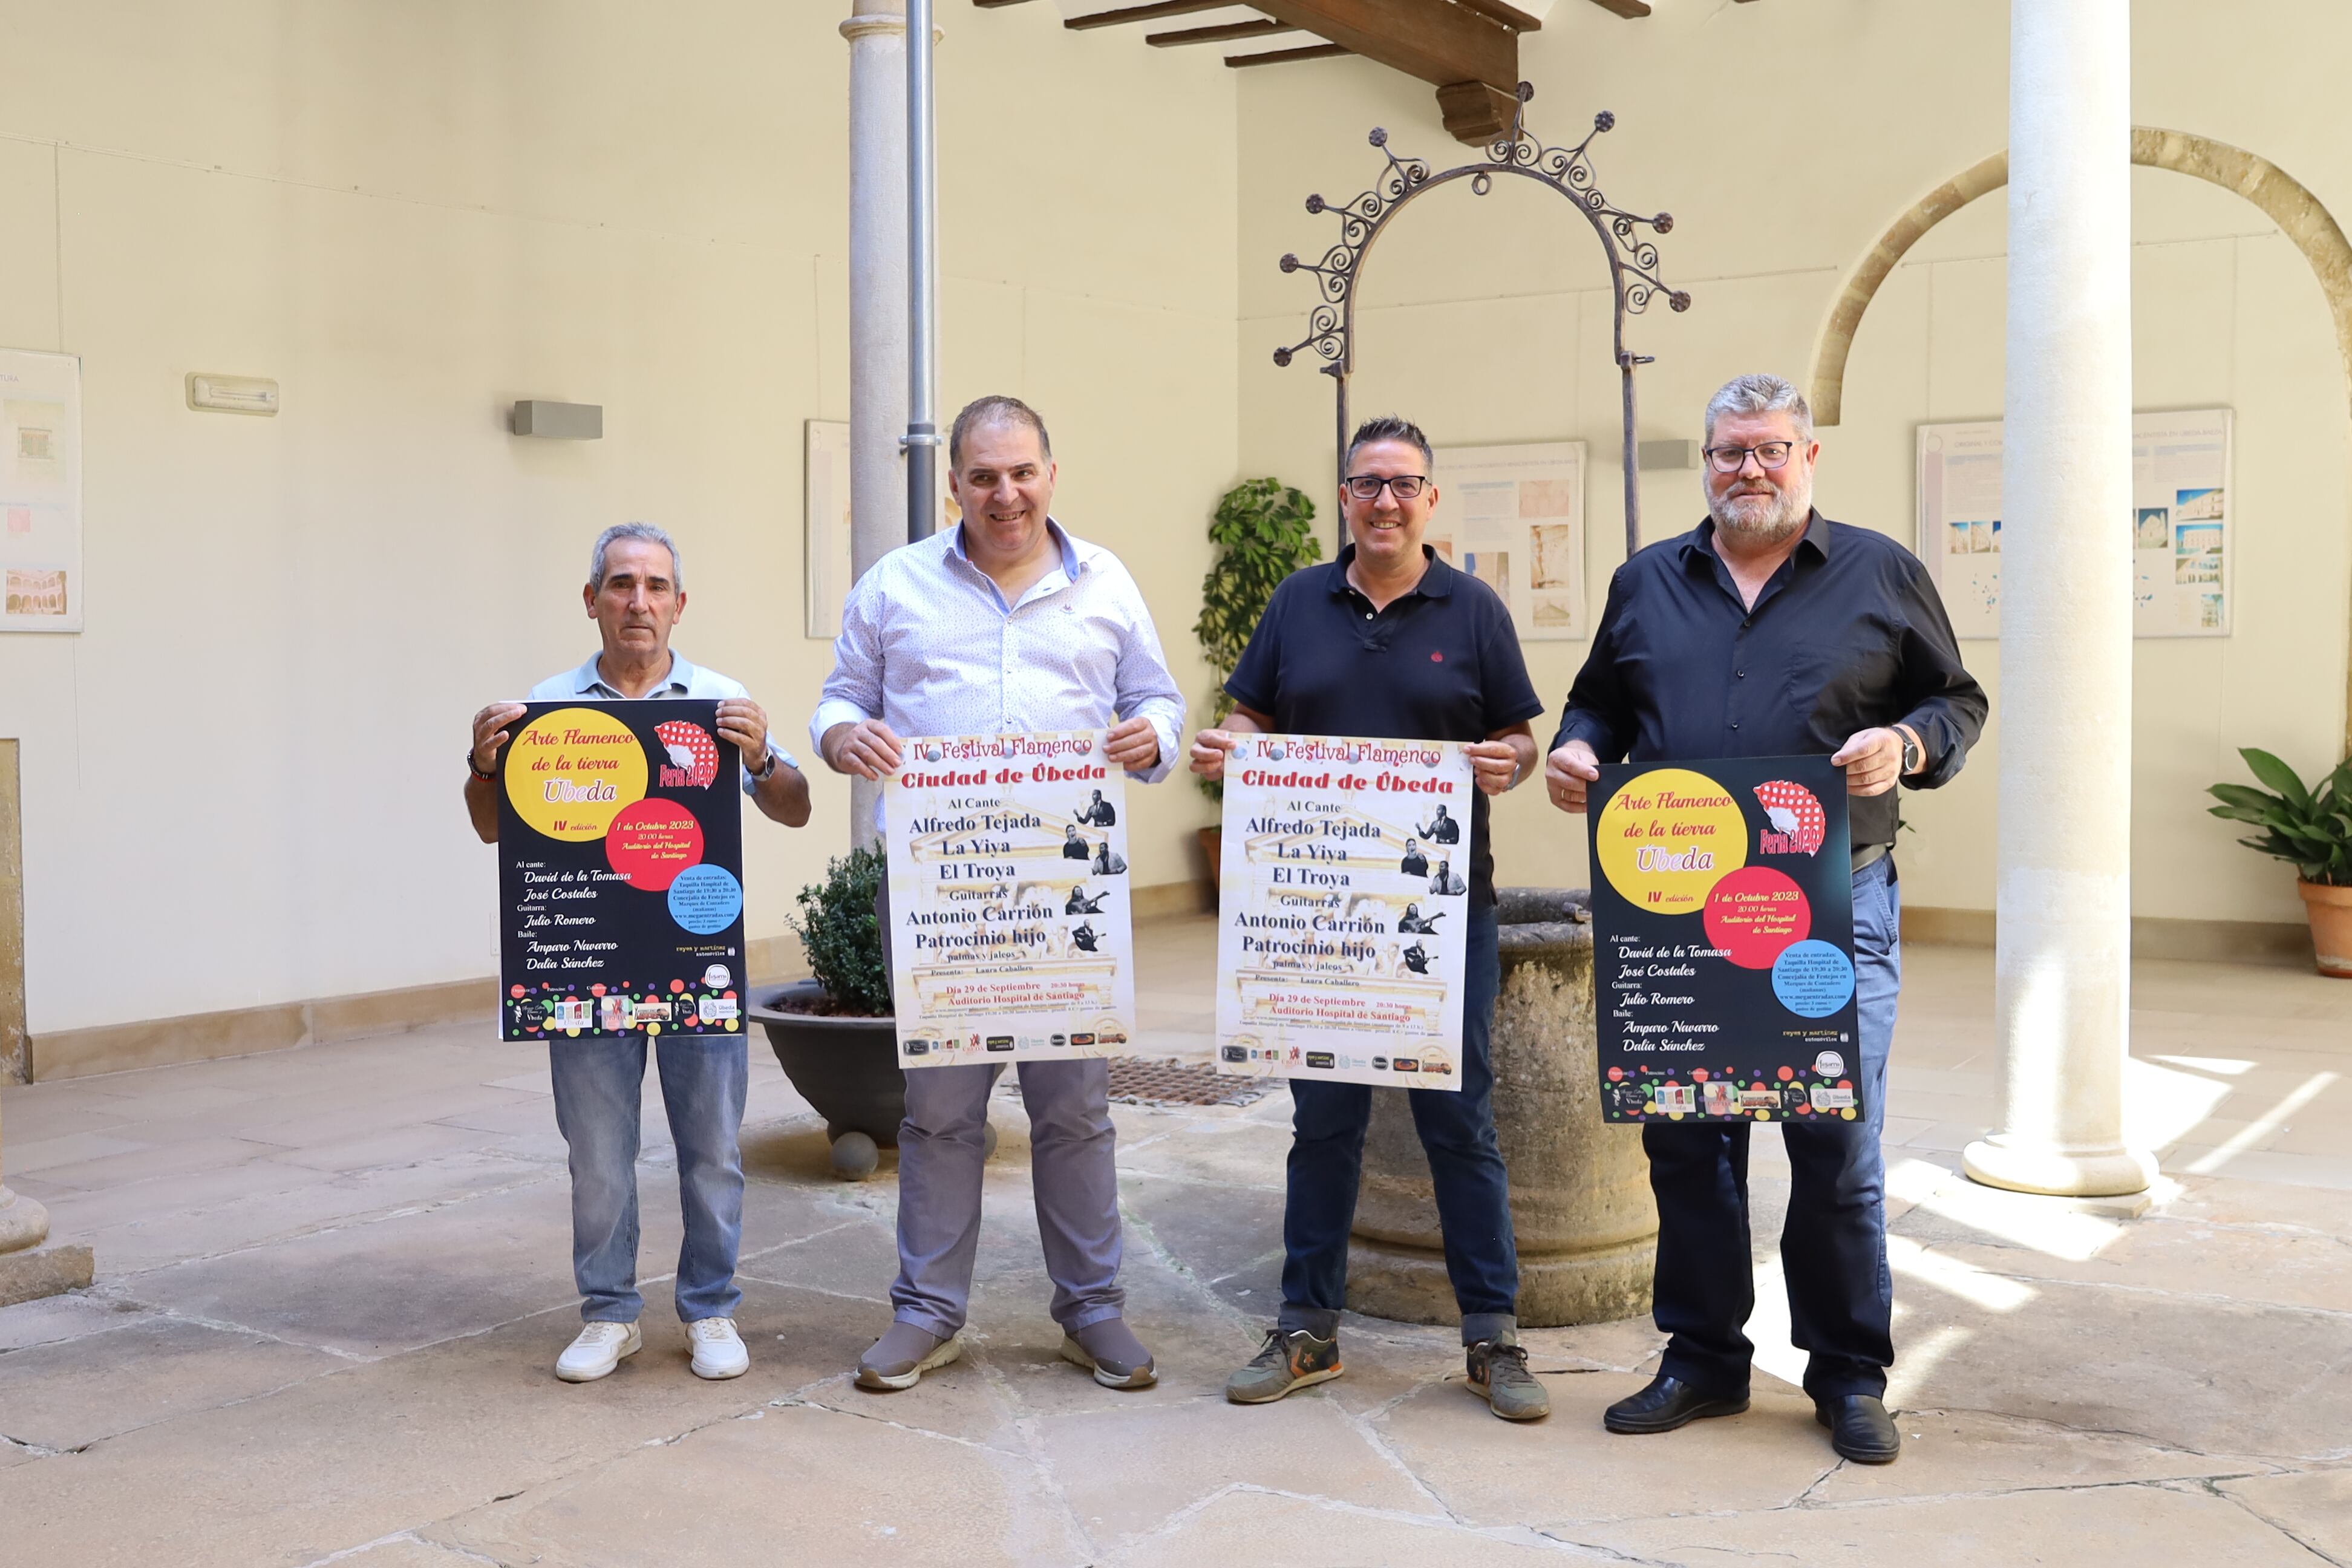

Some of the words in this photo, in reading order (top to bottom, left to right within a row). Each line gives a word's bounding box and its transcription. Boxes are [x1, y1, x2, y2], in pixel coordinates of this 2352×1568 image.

[522, 730, 559, 745] Arte
[563, 729, 636, 745] Flamenco
[913, 743, 930, 760] IV
[941, 738, 1005, 759] Festival
[1011, 737, 1093, 758] Flamenco
[1257, 740, 1274, 757] IV
[1284, 741, 1351, 760] Festival
[1357, 743, 1442, 766] Flamenco
[532, 757, 550, 771] de
[555, 755, 572, 770] la
[578, 757, 619, 770] tierra
[659, 763, 685, 787] Feria
[901, 769, 987, 788] Ciudad
[995, 768, 1023, 783] de
[1031, 762, 1106, 782] Úbeda
[1242, 769, 1330, 788] Ciudad
[1338, 774, 1367, 790] de
[1376, 771, 1452, 794] Úbeda
[544, 777, 617, 803] Úbeda
[948, 799, 961, 809] Al
[965, 798, 1001, 808] Cante
[1287, 800, 1301, 811] Al
[1305, 801, 1341, 813] Cante
[1614, 794, 1651, 811] Arte
[1656, 791, 1733, 809] Flamenco
[554, 820, 567, 831] IV
[570, 823, 598, 831] edición
[616, 822, 621, 831] 1
[635, 822, 667, 831] Octubre
[668, 820, 694, 830] 2023
[909, 817, 976, 834] Alfredo
[981, 814, 1041, 833] Tejada
[1246, 817, 1314, 834] Alfredo
[1320, 820, 1381, 840] Tejada
[1624, 822, 1644, 837] de
[1649, 820, 1666, 837] la
[1671, 822, 1716, 836] tierra
[665, 841, 691, 850] Hospital
[942, 841, 965, 855] La
[971, 839, 1010, 857] Yiya
[1760, 829, 1788, 854] Feria
[661, 852, 687, 860] Santiago
[1278, 843, 1301, 859] La
[1307, 844, 1347, 864] Yiya
[1636, 844, 1714, 872] Úbeda
[524, 872, 558, 883] David
[561, 872, 574, 881] de
[577, 870, 588, 881] la
[590, 870, 632, 881] Tomasa
[939, 864, 959, 880] El
[964, 863, 1016, 881] Troya
[1273, 867, 1292, 883] El
[1298, 868, 1350, 889] Troya
[524, 888, 549, 902] José
[552, 887, 598, 900] Costales
[950, 890, 1007, 901] Guitarras
[1281, 895, 1340, 908] Guitarras
[1648, 892, 1662, 903] IV
[1665, 894, 1694, 903] edición
[1714, 893, 1719, 903] 1
[1722, 893, 1733, 903] de
[1735, 892, 1769, 902] Octubre
[1772, 891, 1798, 901] 2023
[524, 914, 552, 928] Julio
[554, 914, 596, 926] Romero
[906, 909, 976, 926] Antonio
[982, 904, 1053, 922] Carrión
[1767, 914, 1796, 923] Hospital
[1235, 912, 1306, 929] Antonio
[1313, 915, 1385, 934] Carrión
[1763, 926, 1792, 934] Santiago
[915, 930, 1006, 949] Patrocinio
[1013, 929, 1046, 947] hijo
[527, 941, 571, 955] Amparo
[573, 939, 618, 951] Navarro
[1243, 936, 1334, 956] Patrocinio
[1341, 941, 1376, 961] hijo
[1618, 946, 1654, 958] David
[1656, 946, 1670, 958] de
[1673, 945, 1685, 958] la
[1688, 945, 1732, 958] Tomasa
[526, 958, 558, 970] Dalia
[561, 956, 605, 969] Sánchez
[947, 954, 979, 963] palmas
[990, 952, 1015, 961] jaleos
[1272, 960, 1305, 969] palmas
[1316, 961, 1342, 971] jaleos
[1618, 964, 1644, 979] José
[1647, 963, 1696, 976] Costales
[1255, 974, 1288, 982] Presenta:
[1324, 978, 1359, 987] Caballero
[946, 986, 961, 995] Día
[990, 982, 1040, 993] Septiembre
[949, 997, 991, 1006] Auditorio
[994, 995, 1033, 1004] Hospital
[1046, 991, 1085, 1001] Santiago
[1269, 993, 1284, 1002] Día
[1288, 995, 1298, 1003] 29
[1313, 996, 1365, 1007] Septiembre
[1619, 992, 1648, 1007] Julio
[1651, 993, 1695, 1004] Romero
[1269, 1005, 1313, 1016] Auditorio
[1316, 1008, 1355, 1019] Hospital
[1370, 1011, 1410, 1023] Santiago
[1622, 1021, 1669, 1036] Amparo
[1671, 1021, 1719, 1033] Navarro
[1622, 1039, 1656, 1051] Dalia
[1659, 1038, 1705, 1051] Sánchez
